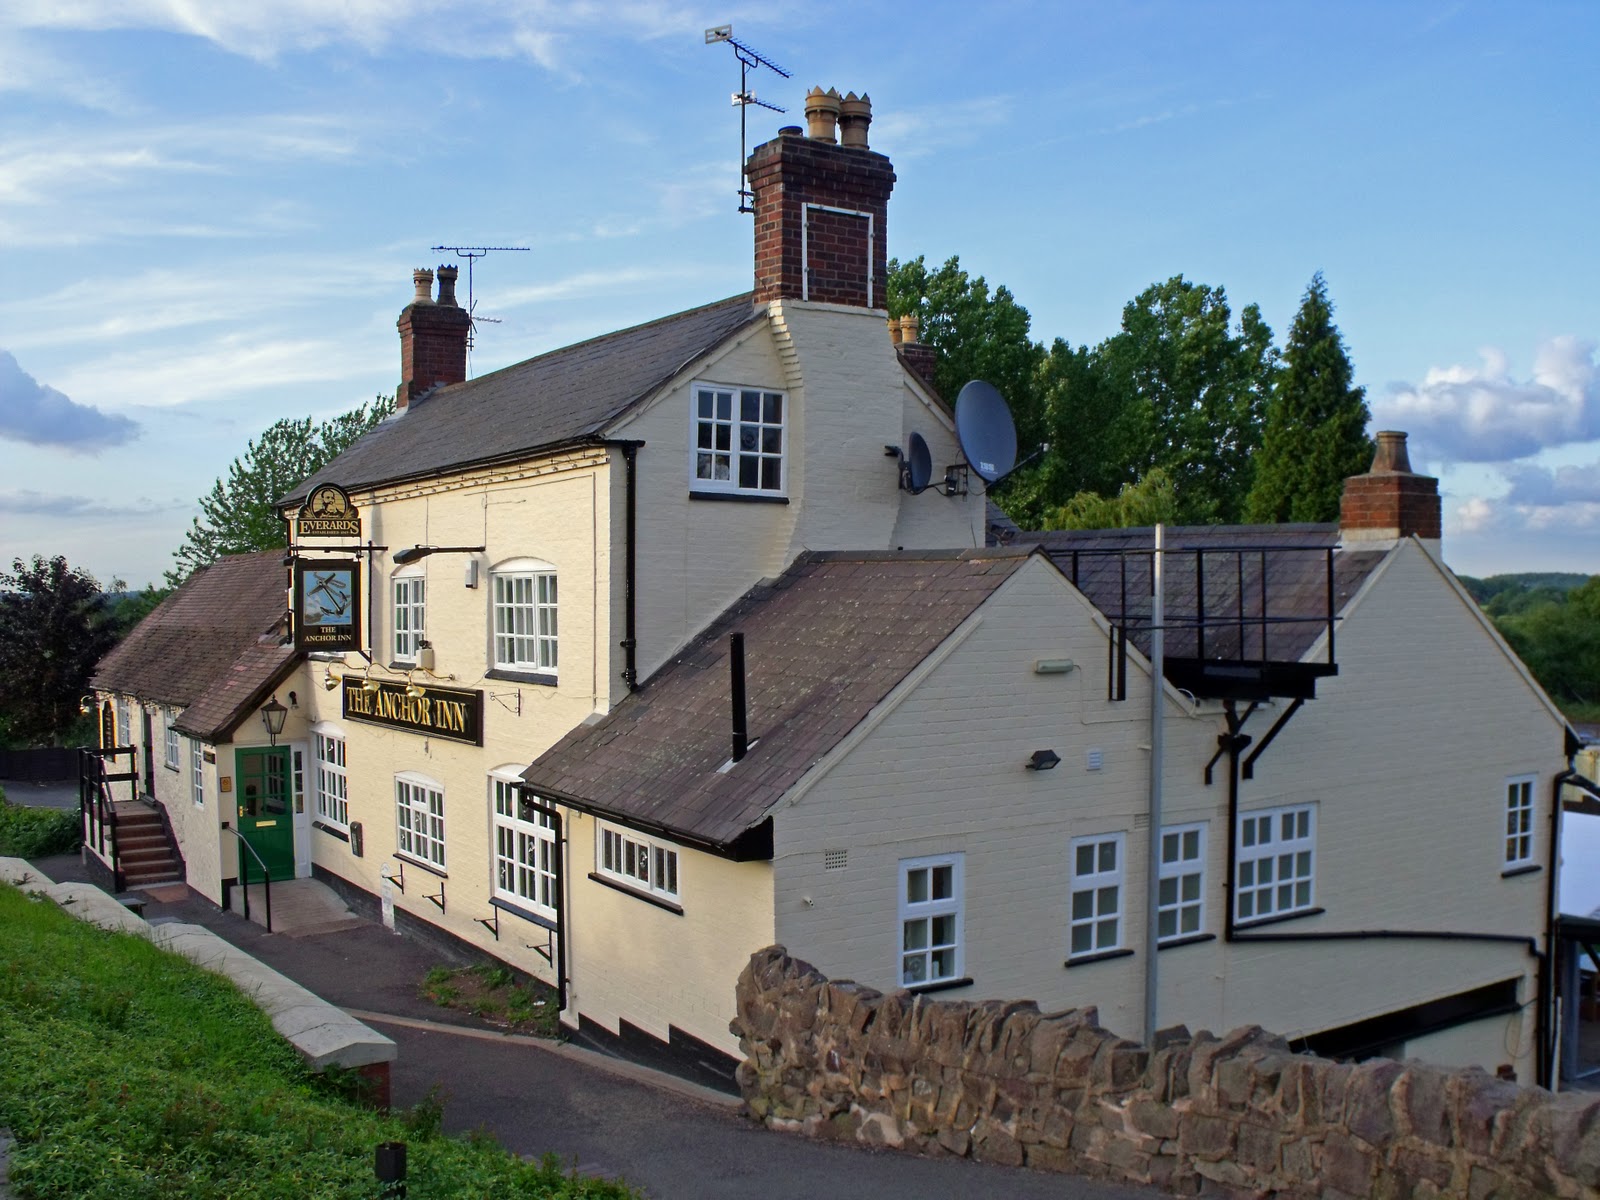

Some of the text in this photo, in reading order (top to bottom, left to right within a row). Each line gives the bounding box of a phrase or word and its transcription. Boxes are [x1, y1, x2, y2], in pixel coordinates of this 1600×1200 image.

[300, 520, 359, 534] EVERARDS
[346, 686, 466, 733] THE ANCHOR INN
